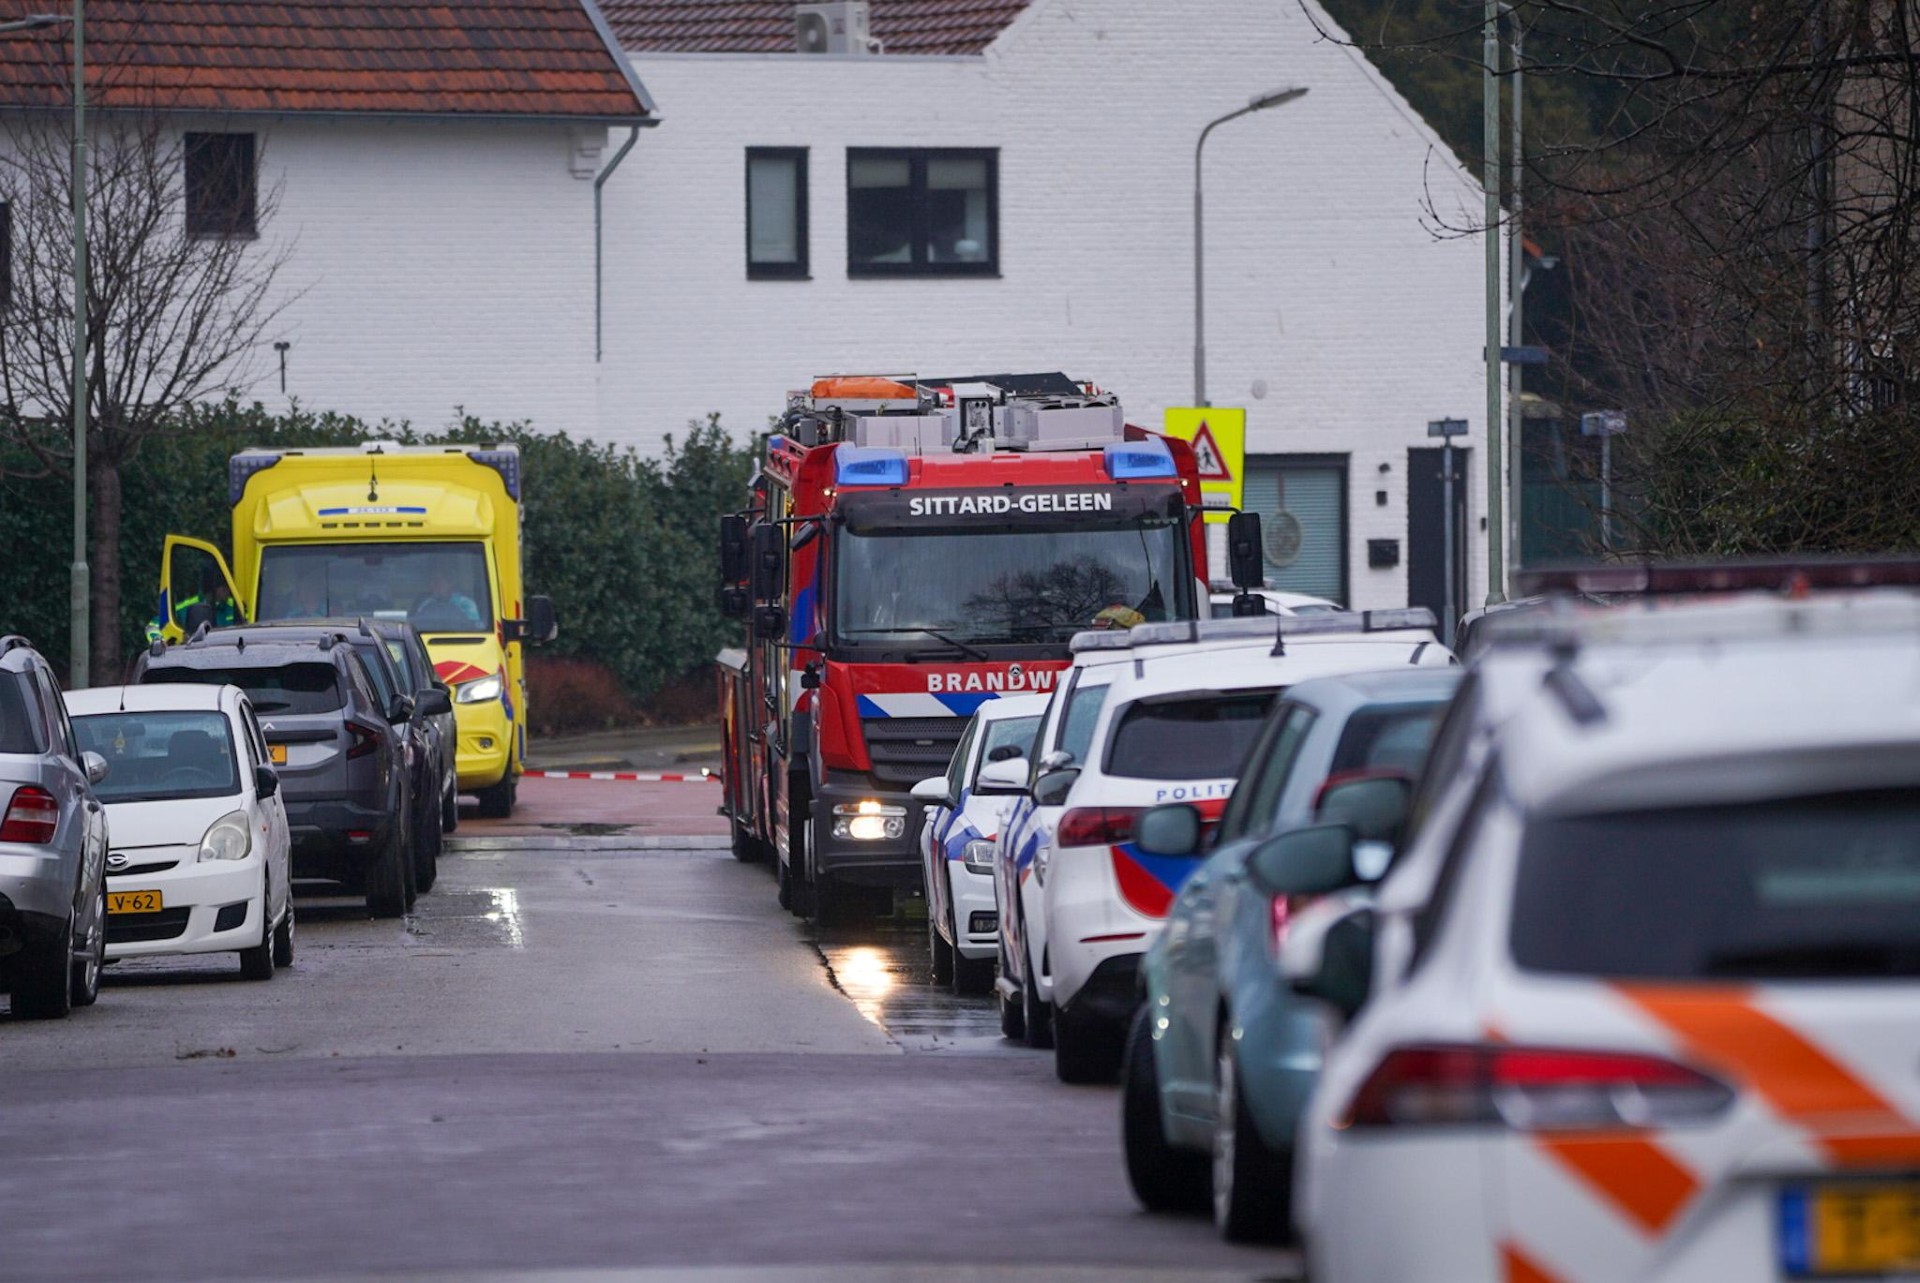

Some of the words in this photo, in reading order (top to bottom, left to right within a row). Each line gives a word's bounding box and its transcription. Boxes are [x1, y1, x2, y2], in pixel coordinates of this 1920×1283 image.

[909, 493, 1112, 515] SITTARD-GELEEN
[927, 670, 1061, 692] BRANDW
[1156, 784, 1228, 801] POLIT
